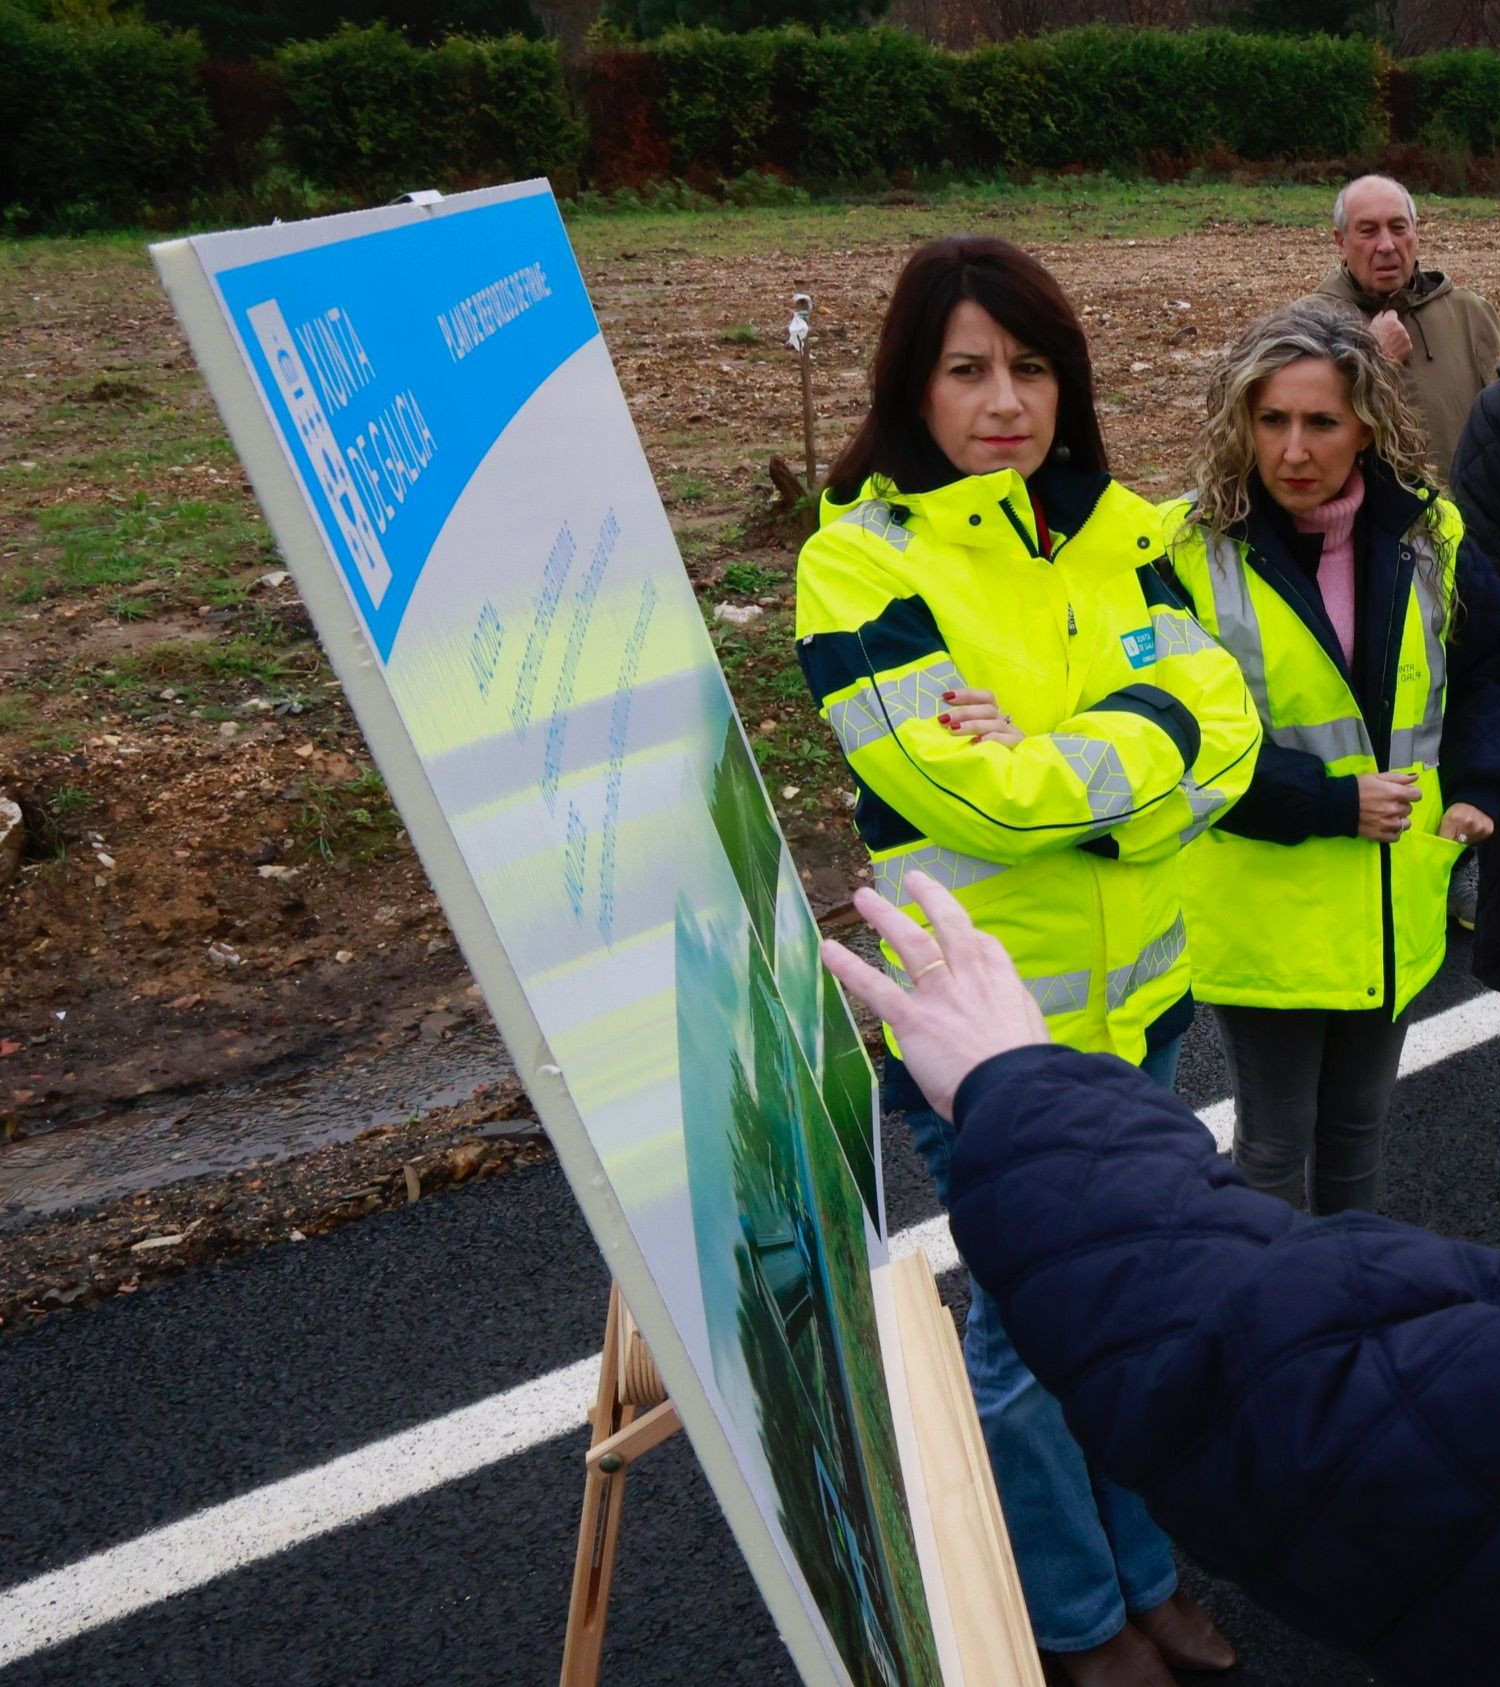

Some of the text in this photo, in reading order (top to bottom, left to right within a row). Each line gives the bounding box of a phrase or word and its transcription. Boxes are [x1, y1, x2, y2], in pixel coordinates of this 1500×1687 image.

[296, 306, 377, 416] XUNTA
[437, 304, 473, 364] PLAN
[459, 296, 484, 346] DE
[472, 278, 519, 337] REFORZOS
[508, 270, 529, 312] DE
[346, 387, 438, 534] DE GALICIA
[466, 630, 495, 703] ANO
[563, 848, 586, 924] ANO
